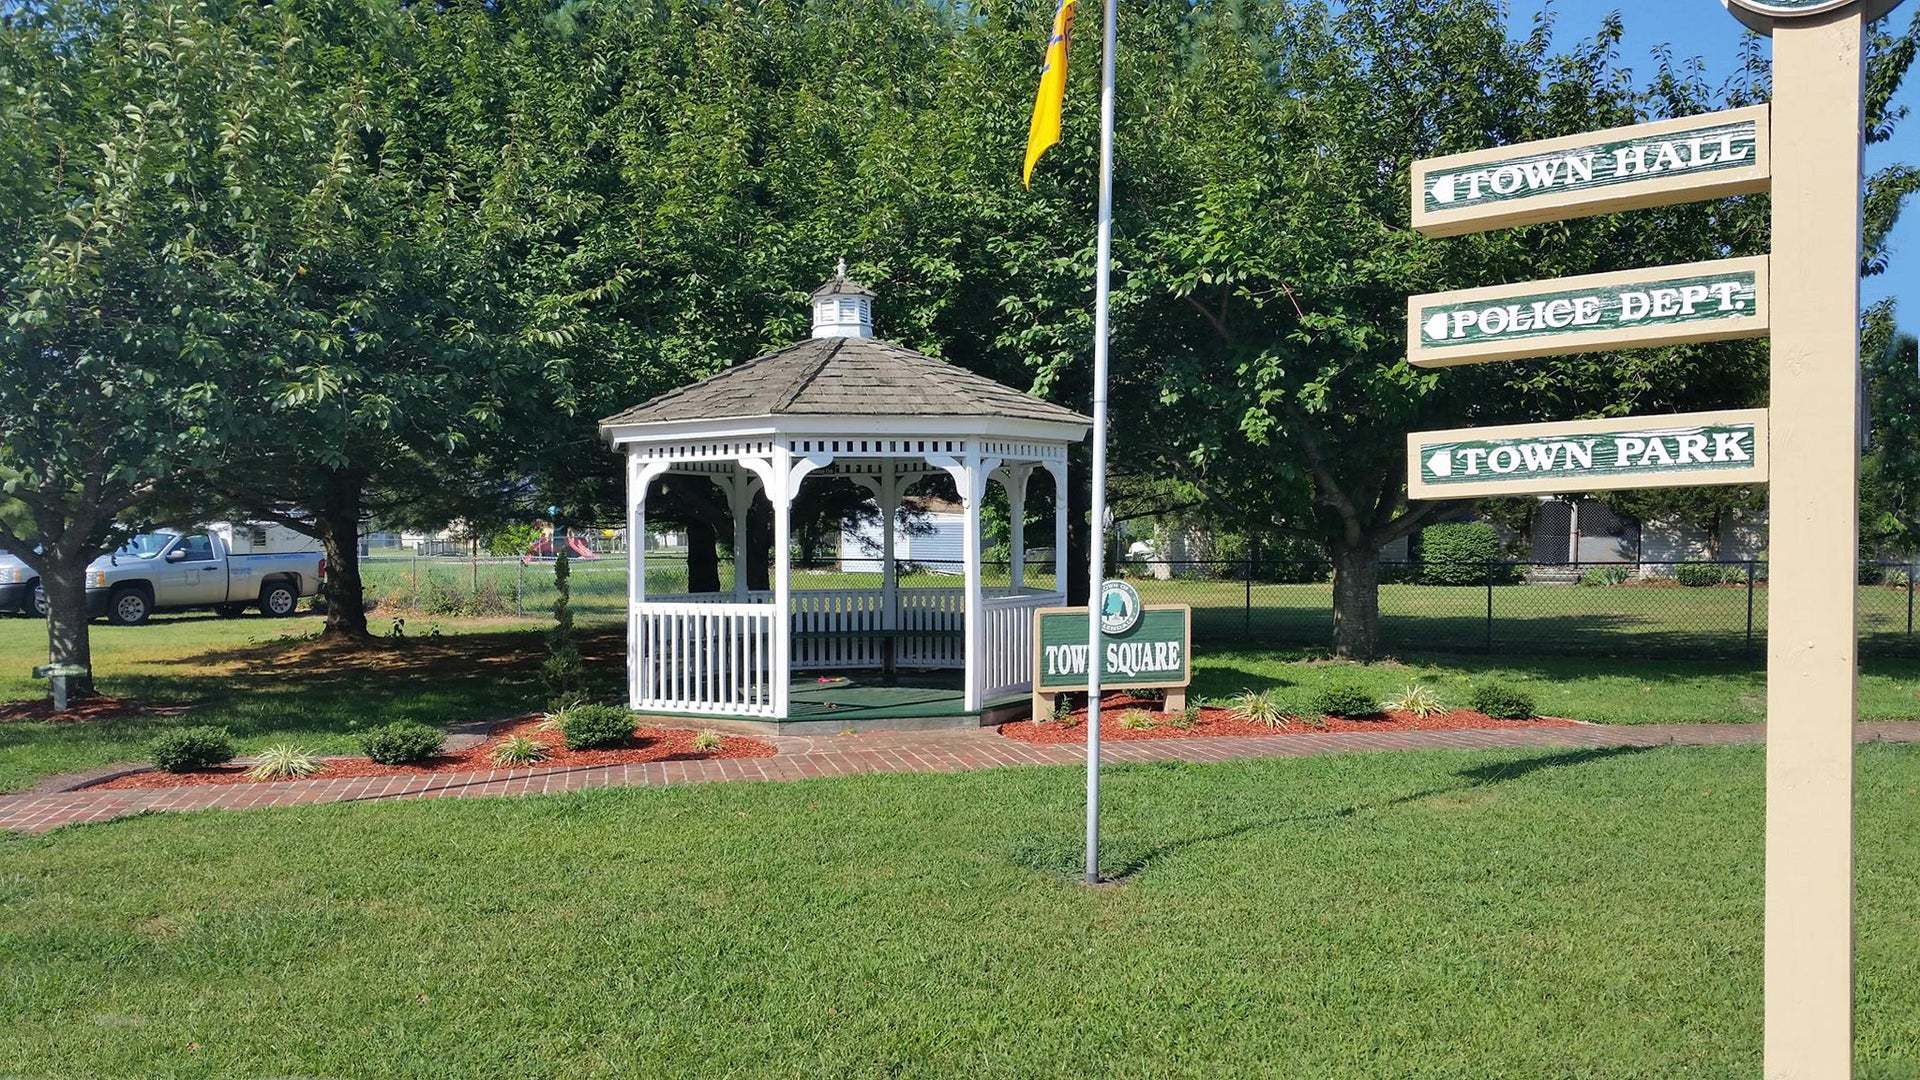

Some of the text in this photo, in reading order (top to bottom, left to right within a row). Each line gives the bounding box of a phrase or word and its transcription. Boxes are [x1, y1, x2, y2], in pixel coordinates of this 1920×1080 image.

[1457, 133, 1749, 200] TOWN HALL
[1450, 281, 1746, 339] POLICE DEPT.
[1456, 431, 1751, 477] TOWN PARK
[1046, 641, 1181, 677] TOW SQUARE
